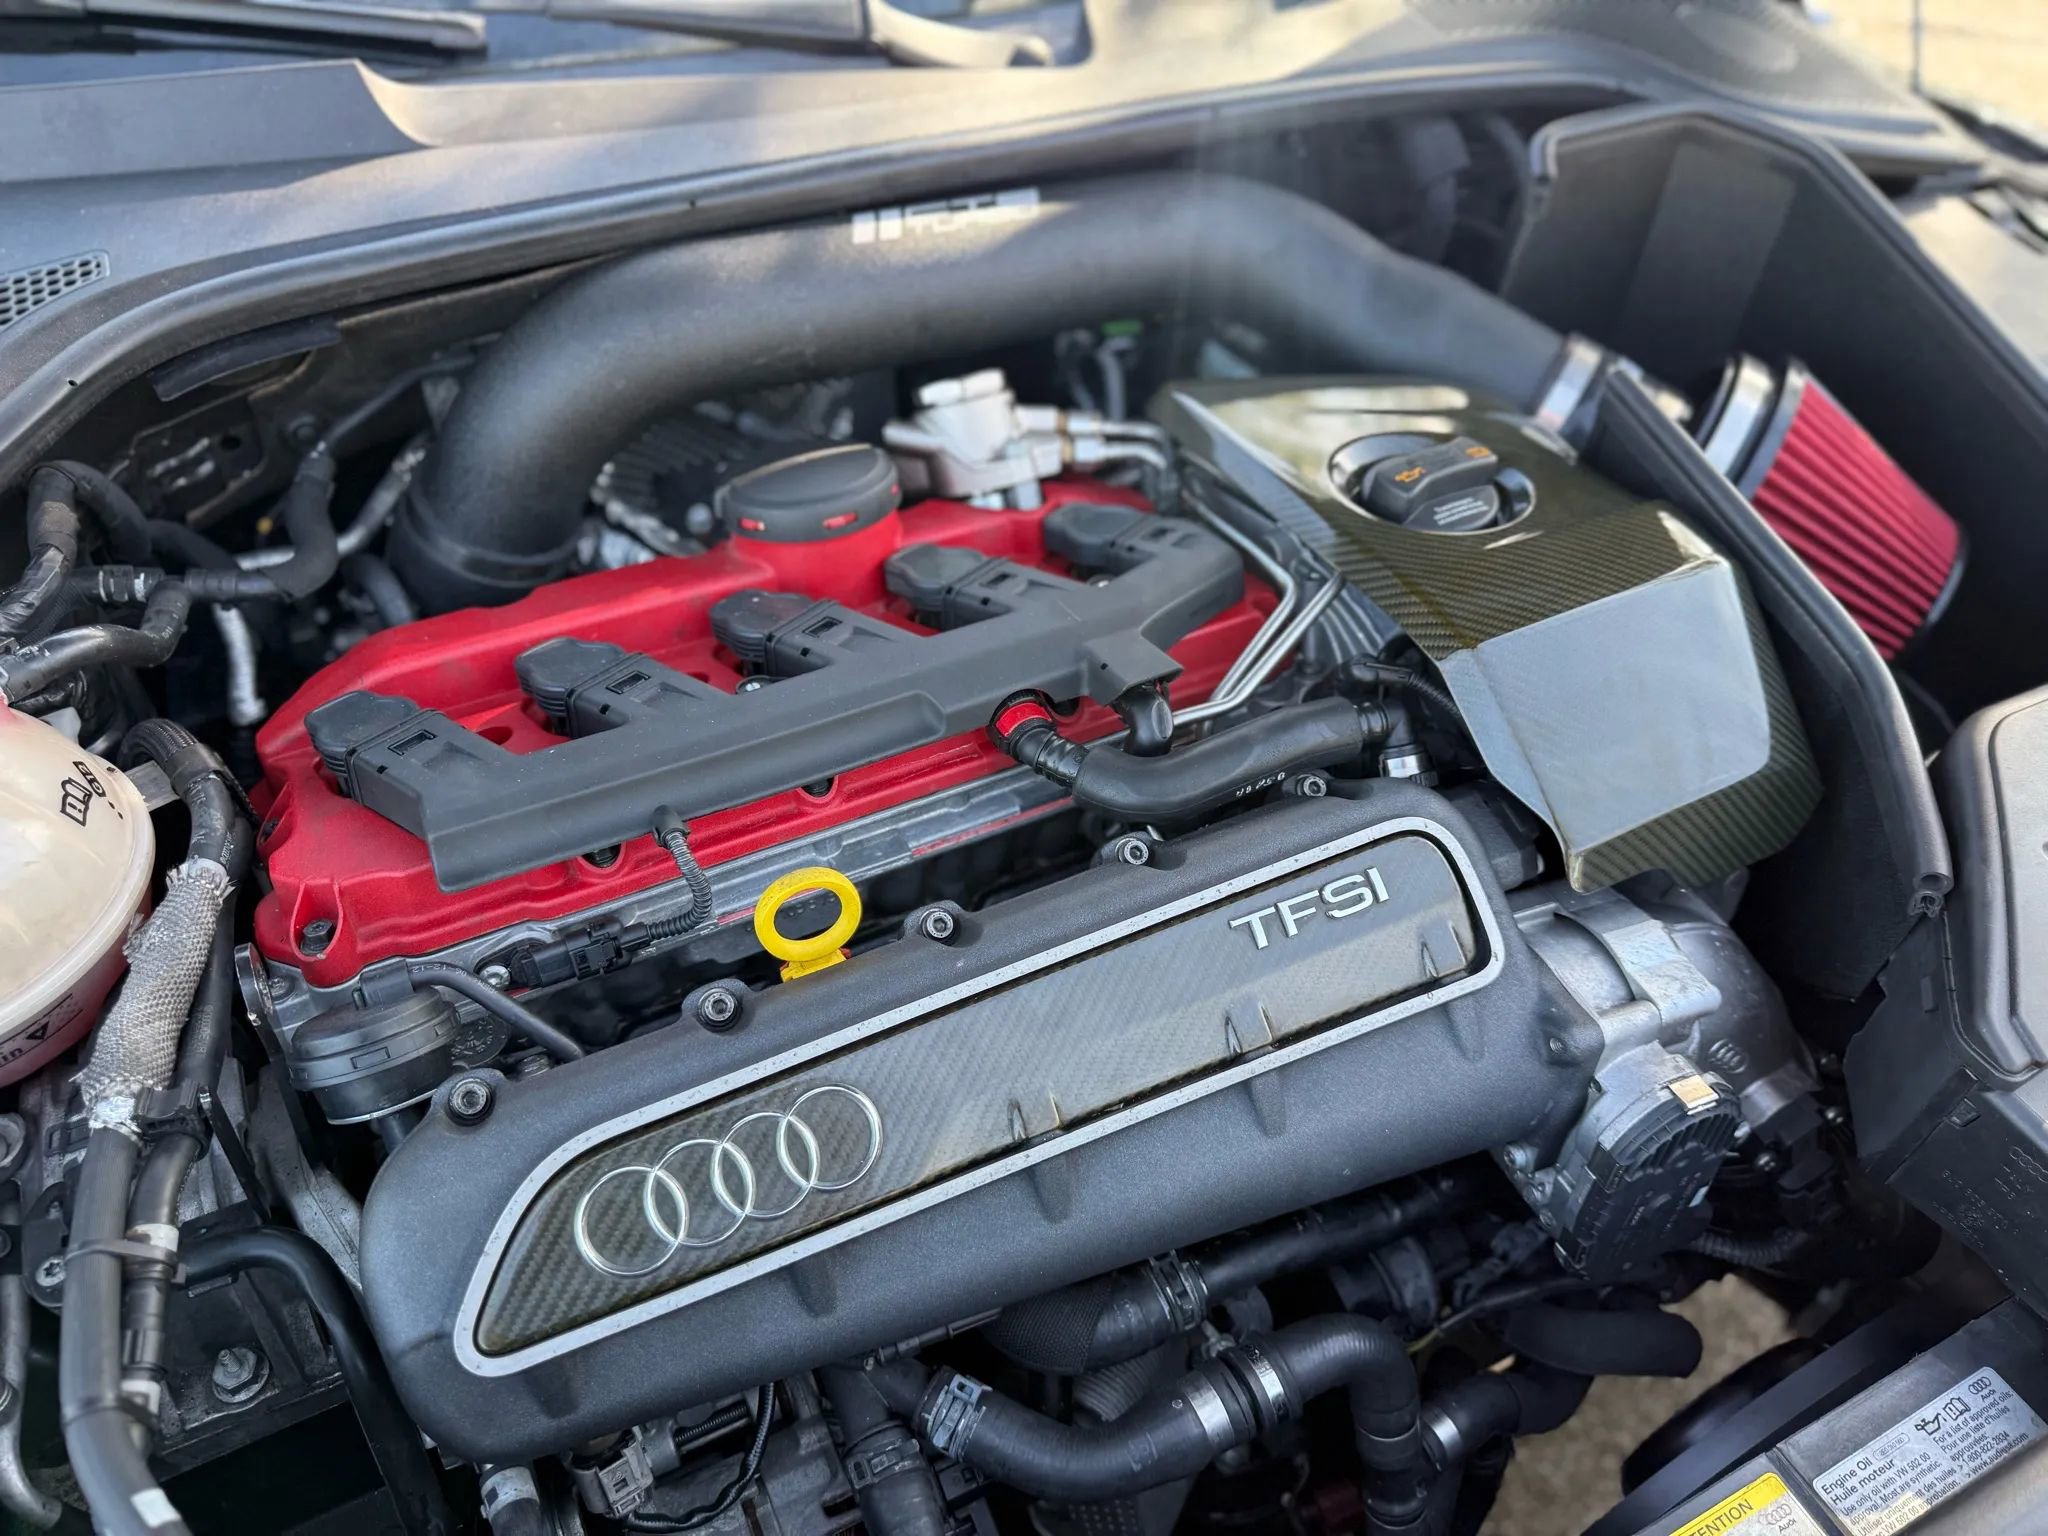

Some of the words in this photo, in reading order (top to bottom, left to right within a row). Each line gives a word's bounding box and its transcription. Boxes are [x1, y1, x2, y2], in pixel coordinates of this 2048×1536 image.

[1228, 867, 1390, 950] TFSI
[0, 1047, 23, 1065] in
[1980, 1389, 1996, 1402] Audi
[1933, 1434, 1947, 1446] For
[1950, 1423, 1963, 1435] list
[1962, 1417, 1971, 1428] of
[1969, 1397, 2000, 1423] approved
[1940, 1440, 1959, 1455] Pour
[1957, 1431, 1972, 1443] une
[1969, 1420, 1986, 1434] liste
[1984, 1405, 2010, 1426] d'huiles
[1970, 1432, 2030, 1475] www.audiusa.com
[1821, 1470, 1857, 1495] Engine
[1856, 1456, 1873, 1471] Oil
[1830, 1486, 1858, 1506] Huile
[1858, 1458, 1895, 1488] moteur
[1840, 1504, 1857, 1517] Use
[1856, 1493, 1873, 1507] only
[1871, 1484, 1882, 1496] oil
[1880, 1475, 1897, 1490] with
[1893, 1466, 1909, 1479] VW
[1907, 1457, 1922, 1471] 502
[1919, 1452, 1931, 1463] 00
[1879, 1488, 1901, 1505] Most
[1898, 1480, 1911, 1492] are
[1857, 1516, 1886, 1536] Utilisez
[1884, 1488, 1926, 1520] uniquement
[1922, 1480, 1938, 1494] des
[1934, 1467, 1957, 1485] huiles
[1881, 1520, 1897, 1534] VW
[1895, 1511, 1911, 1526] 502
[1908, 1505, 1920, 1516] 00
[1778, 1518, 1798, 1534] Audi
